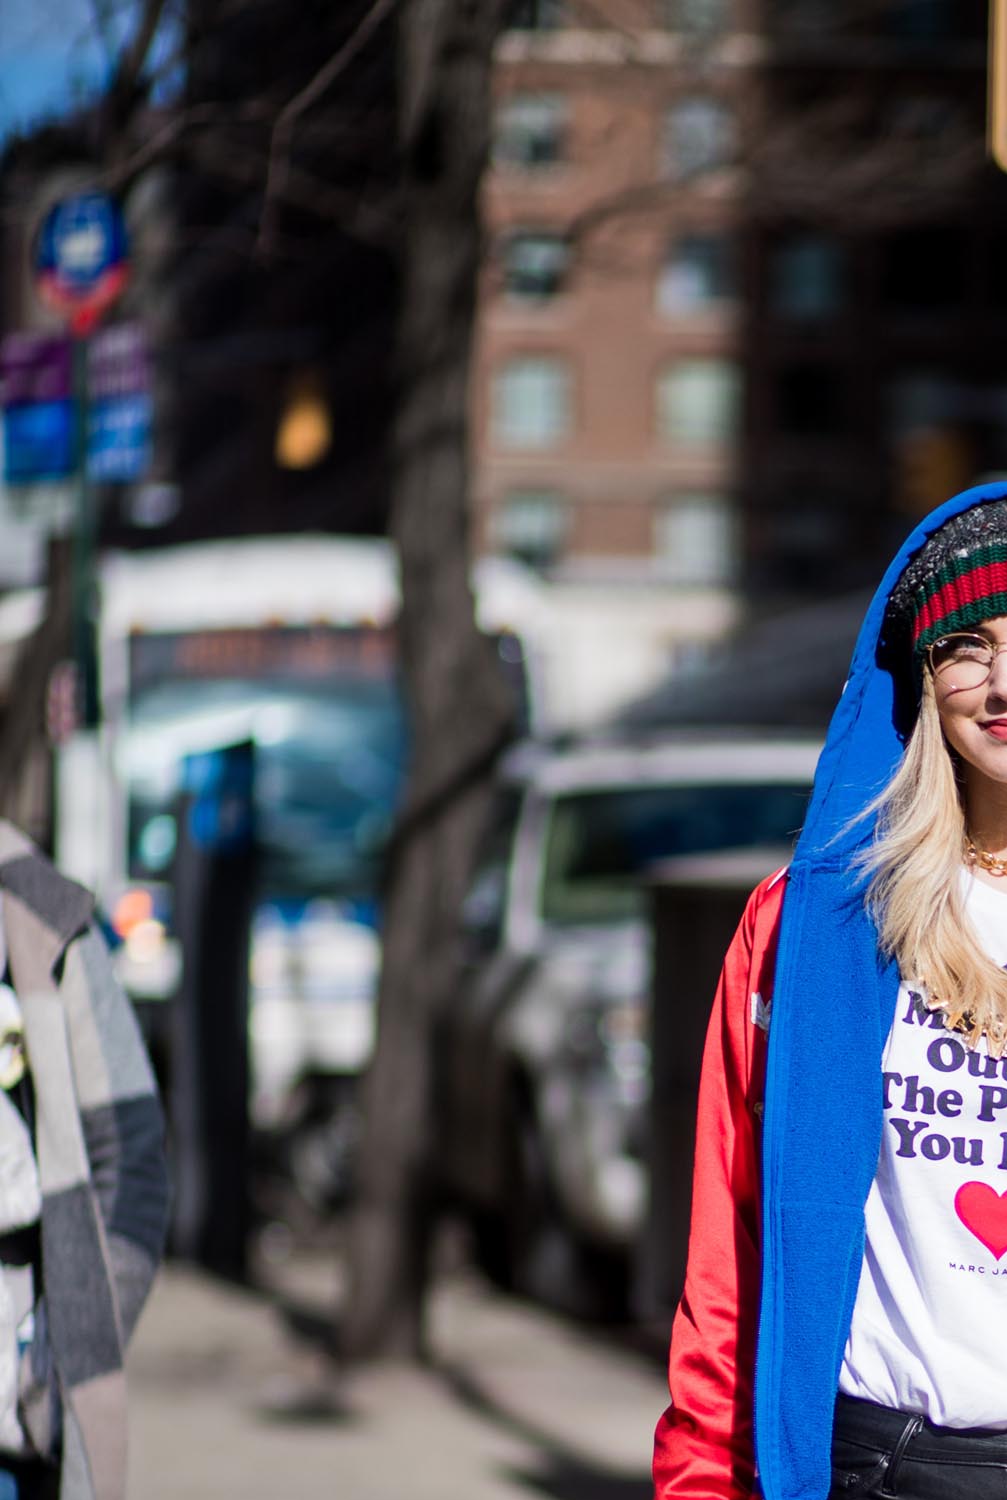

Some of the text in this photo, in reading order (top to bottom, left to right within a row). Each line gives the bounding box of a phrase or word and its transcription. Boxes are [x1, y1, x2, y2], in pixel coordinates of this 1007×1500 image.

[883, 1072, 963, 1118] The
[889, 1117, 984, 1166] You
[949, 1262, 986, 1274] MARC
